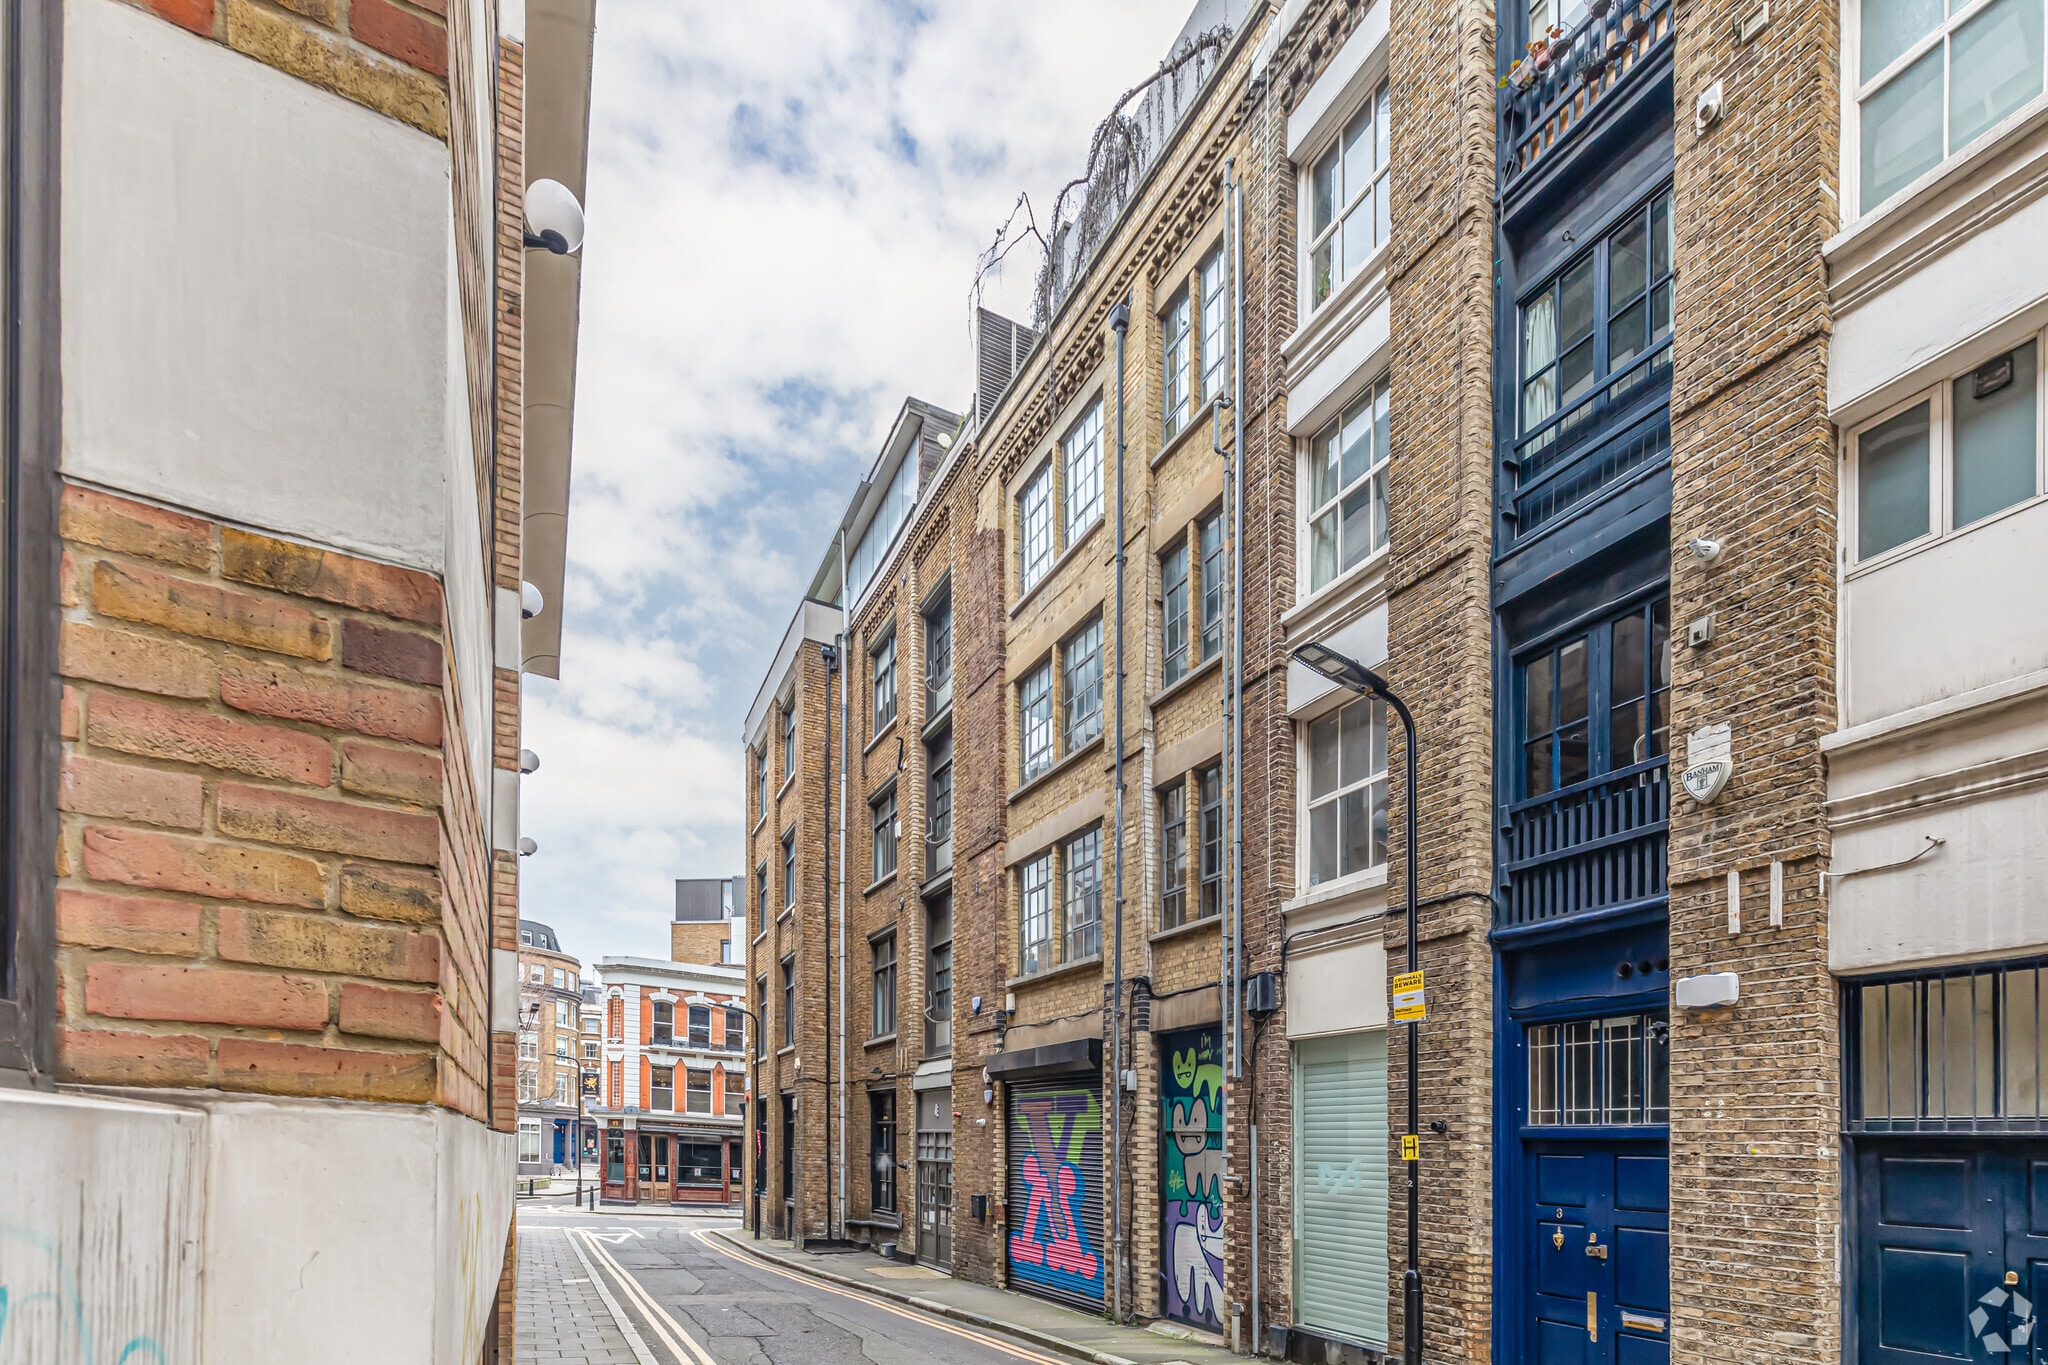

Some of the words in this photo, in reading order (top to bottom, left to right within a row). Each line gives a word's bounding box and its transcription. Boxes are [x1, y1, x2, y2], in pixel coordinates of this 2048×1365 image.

[1686, 764, 1719, 782] BANHAM
[1394, 979, 1422, 989] BEWARE
[1403, 1137, 1417, 1158] H
[1556, 1207, 1563, 1219] 3
